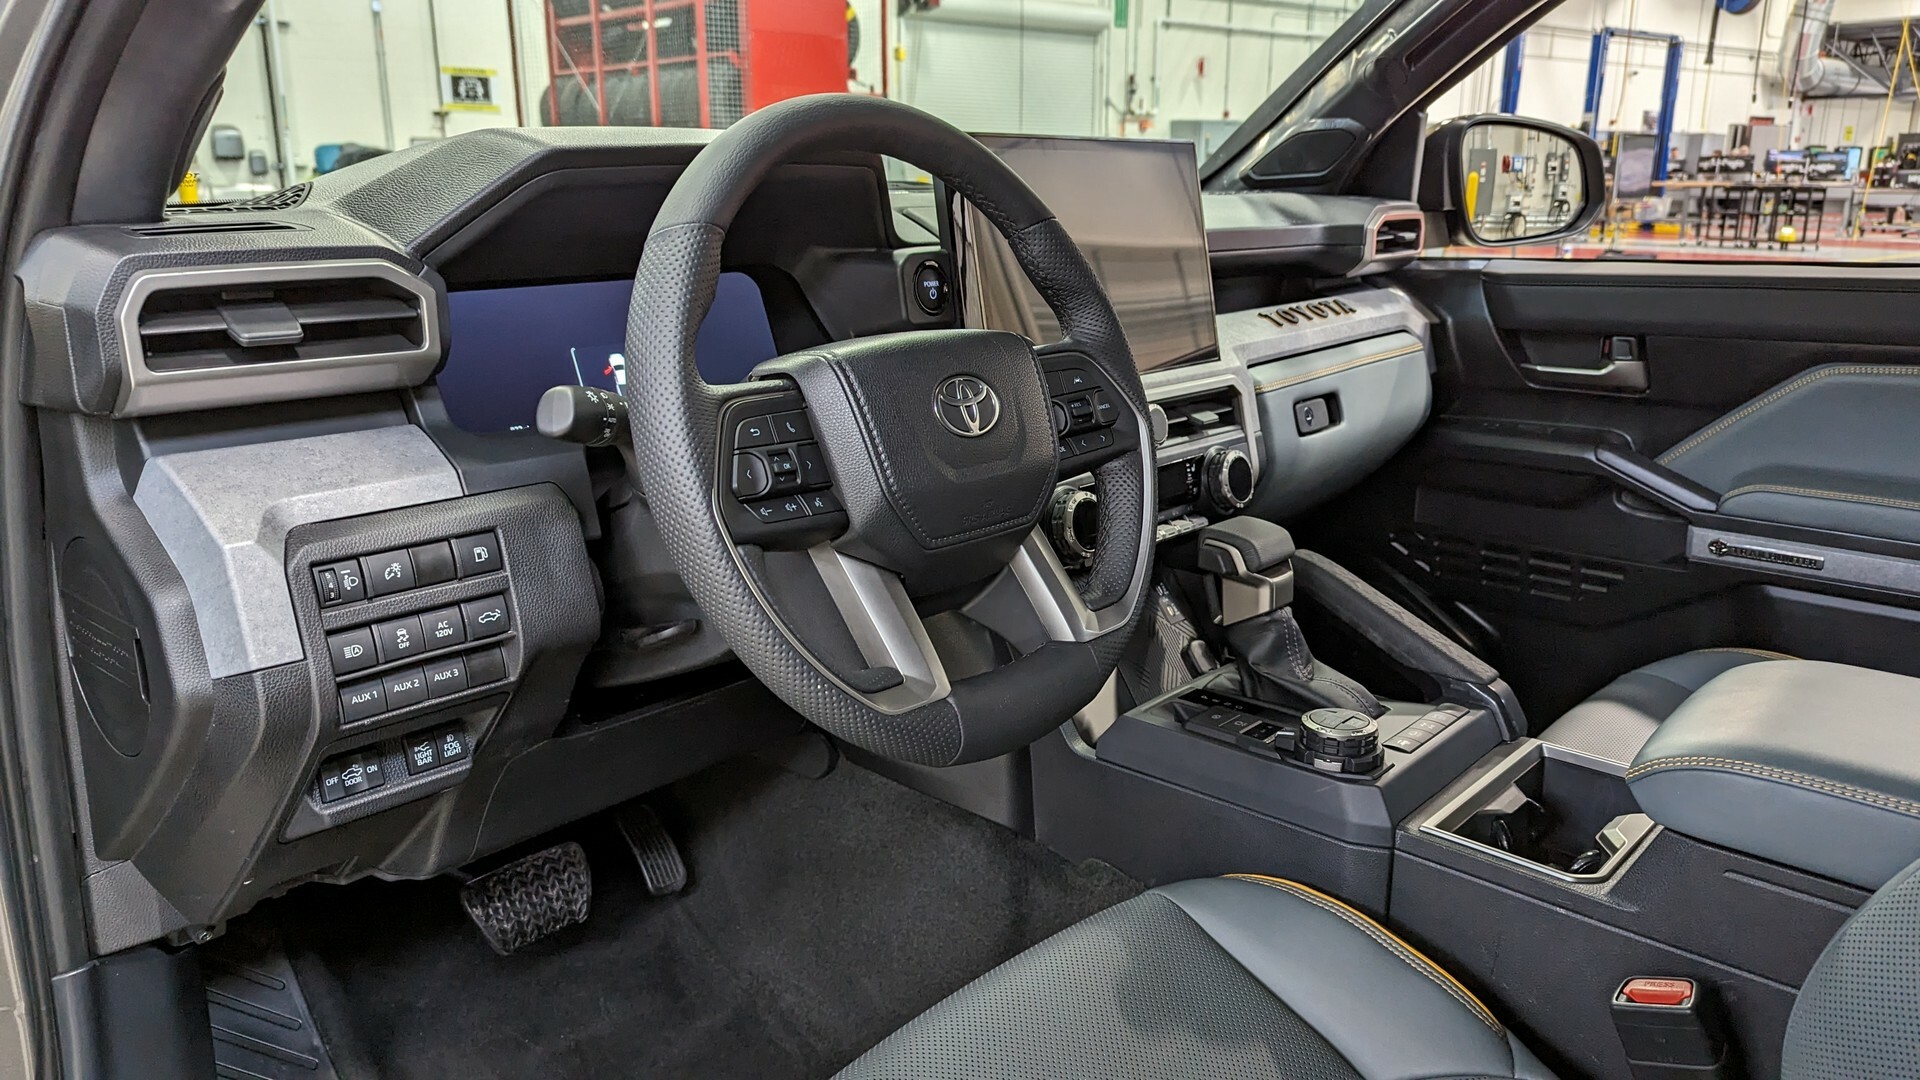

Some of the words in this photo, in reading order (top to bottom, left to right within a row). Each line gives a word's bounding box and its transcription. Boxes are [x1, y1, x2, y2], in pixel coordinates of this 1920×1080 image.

[923, 280, 940, 288] POWER
[1257, 299, 1357, 327] TOYOTA
[783, 462, 792, 470] OK
[437, 620, 449, 630] AC
[435, 627, 453, 638] 120V
[398, 641, 410, 649] OFF
[433, 670, 452, 682] AUX
[452, 668, 459, 677] 3
[393, 680, 412, 693] AUX
[413, 679, 420, 688] 2
[351, 692, 371, 705] AUX
[372, 690, 378, 699] 1
[444, 740, 460, 751] FOG
[414, 748, 433, 760] LIGHT
[444, 746, 462, 758] LIGHT
[417, 756, 433, 767] BAR
[366, 764, 378, 774] ON
[325, 776, 339, 787] OFF
[344, 776, 363, 787] DOOR
[1643, 980, 1676, 988] PRESS
